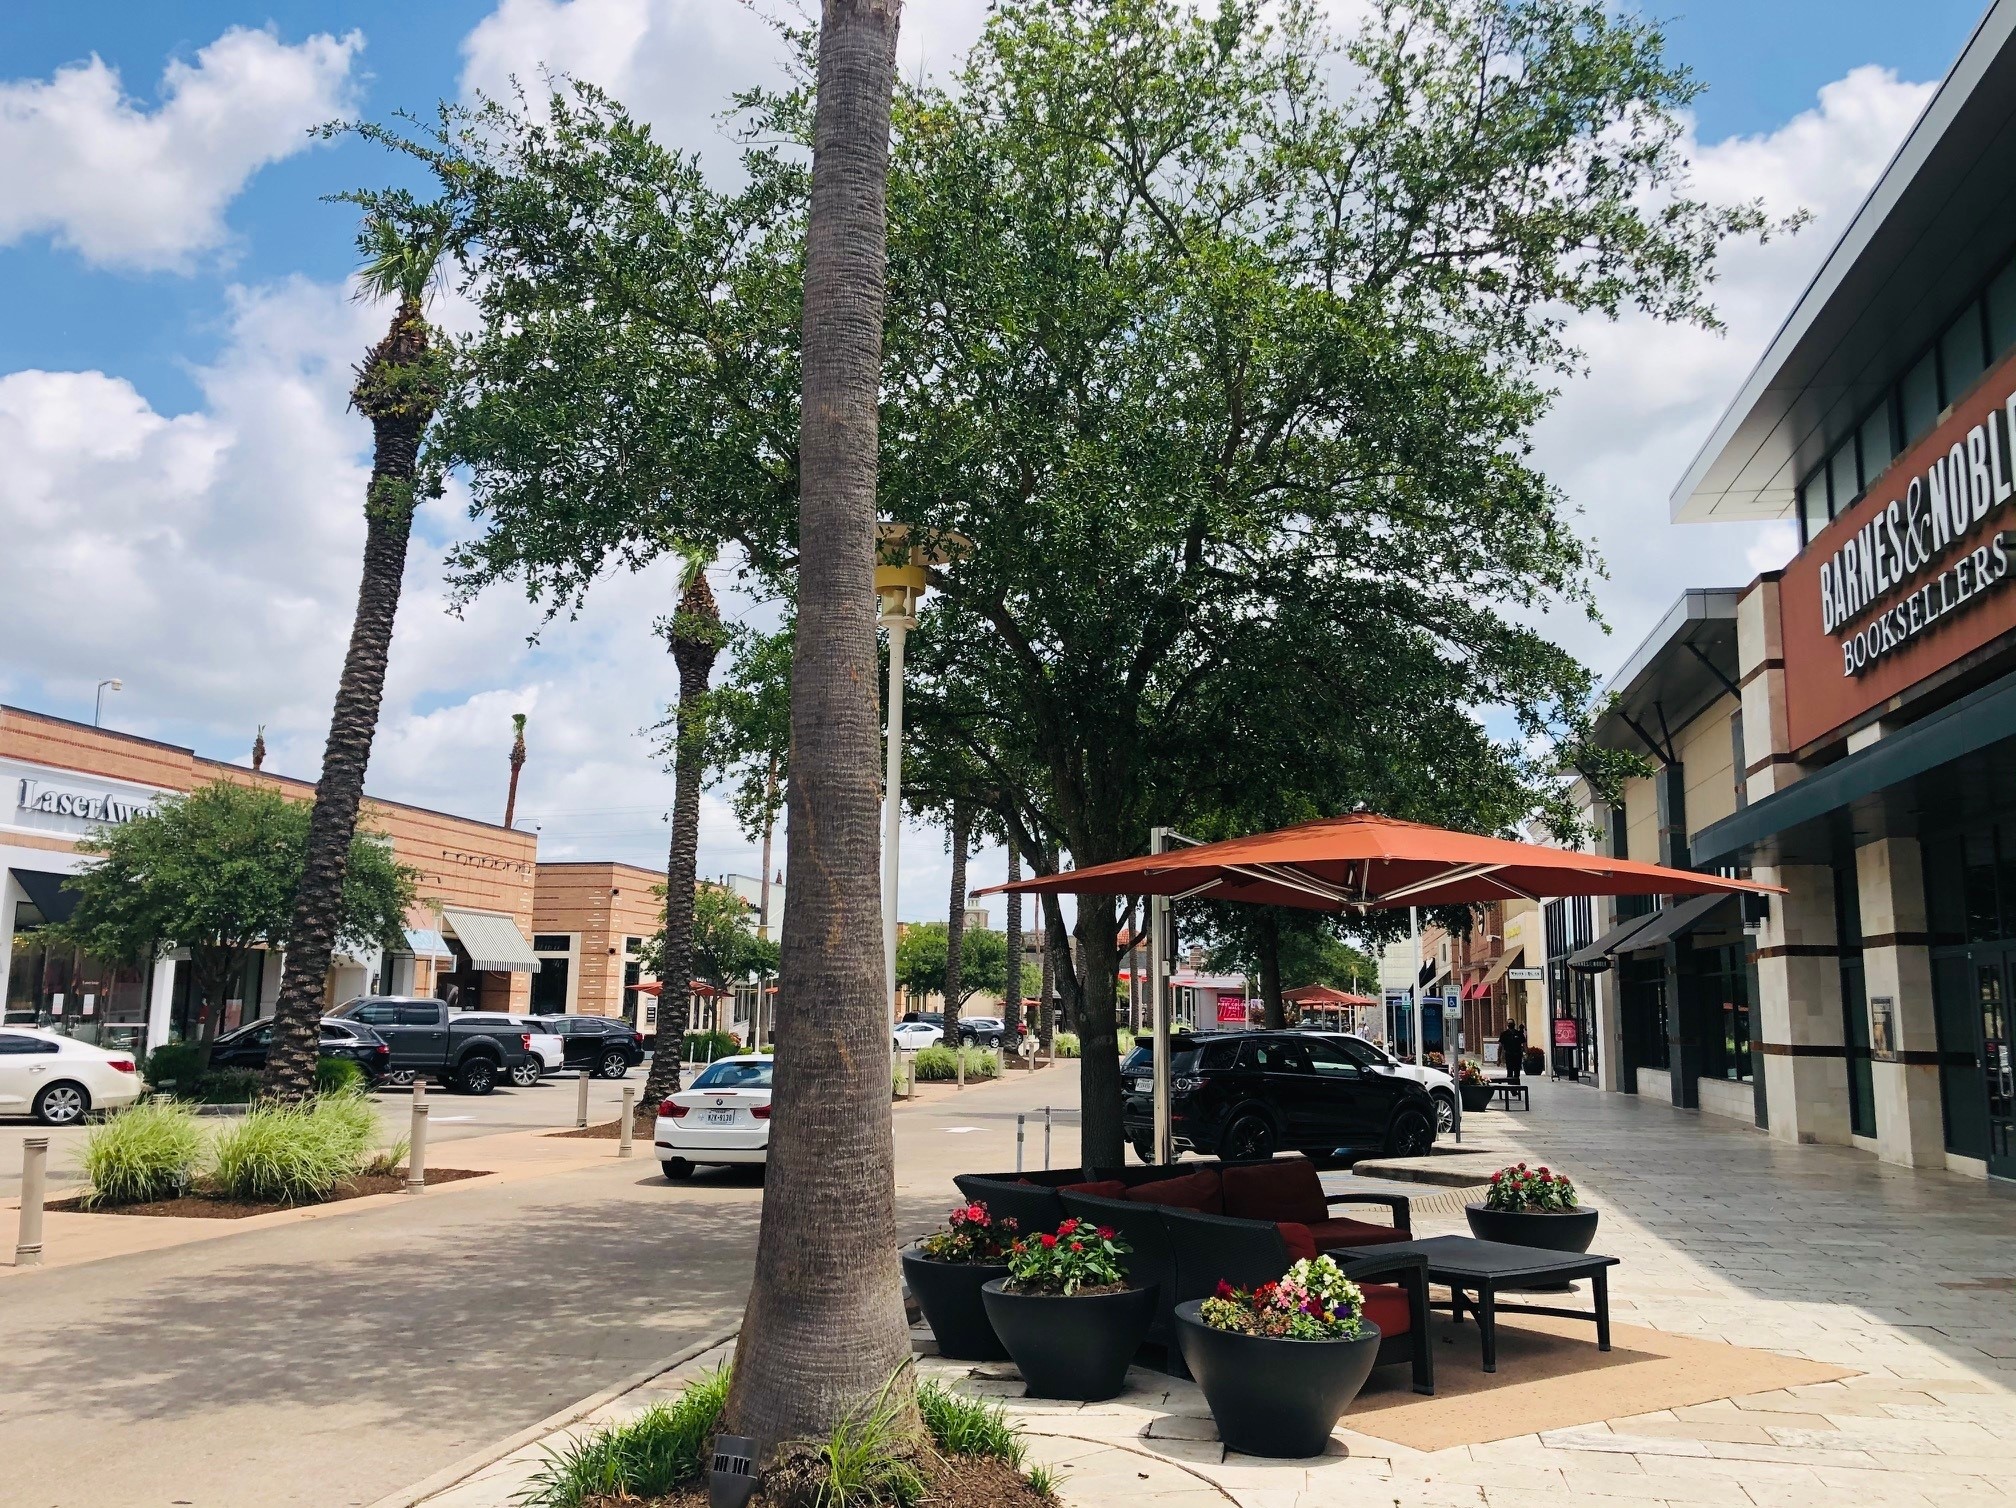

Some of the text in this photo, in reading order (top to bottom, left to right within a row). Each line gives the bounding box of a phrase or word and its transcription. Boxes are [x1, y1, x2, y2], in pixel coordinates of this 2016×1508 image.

[1820, 499, 1903, 636] BARNES
[1904, 475, 1932, 575] &
[1841, 531, 2009, 678] BOOKSELLERS
